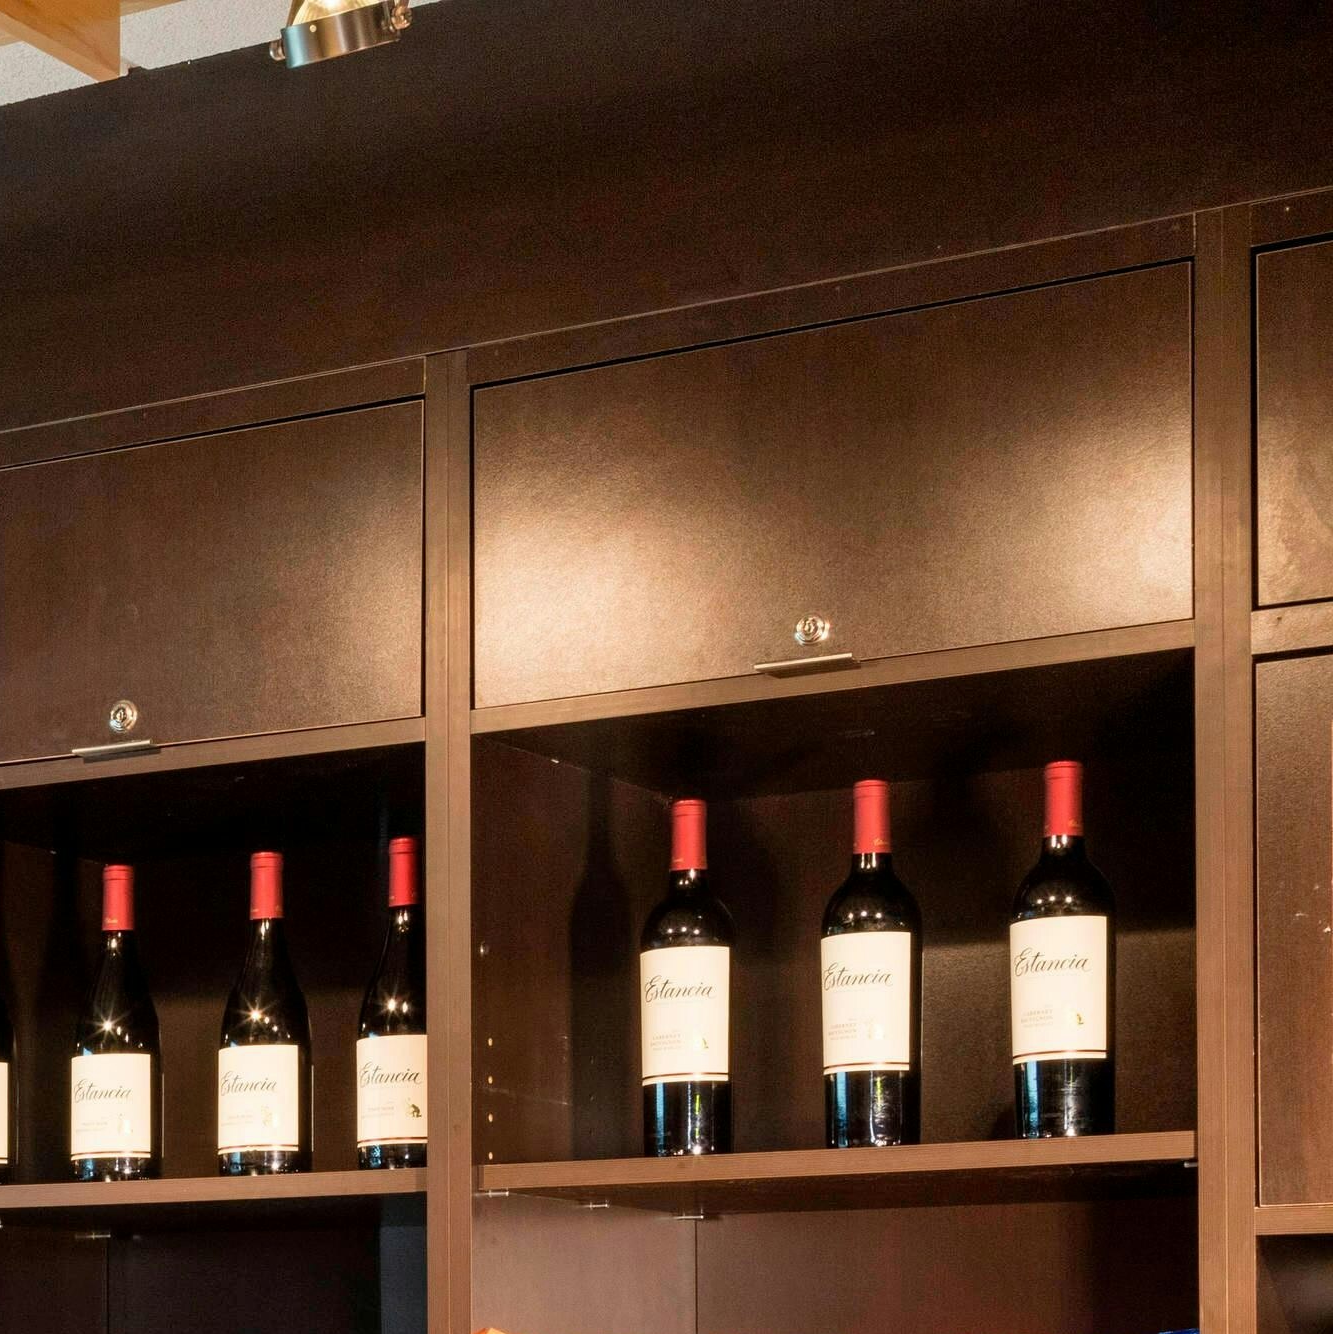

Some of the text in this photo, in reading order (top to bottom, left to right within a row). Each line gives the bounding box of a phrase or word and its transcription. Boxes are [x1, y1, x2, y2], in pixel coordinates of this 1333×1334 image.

[1014, 947, 1092, 977] Estancia
[645, 975, 716, 1003] Estancia
[824, 962, 893, 991] Estancia
[220, 1069, 279, 1097] Estancia
[359, 1060, 423, 1088] Estancia
[74, 1078, 134, 1103] Estancia
